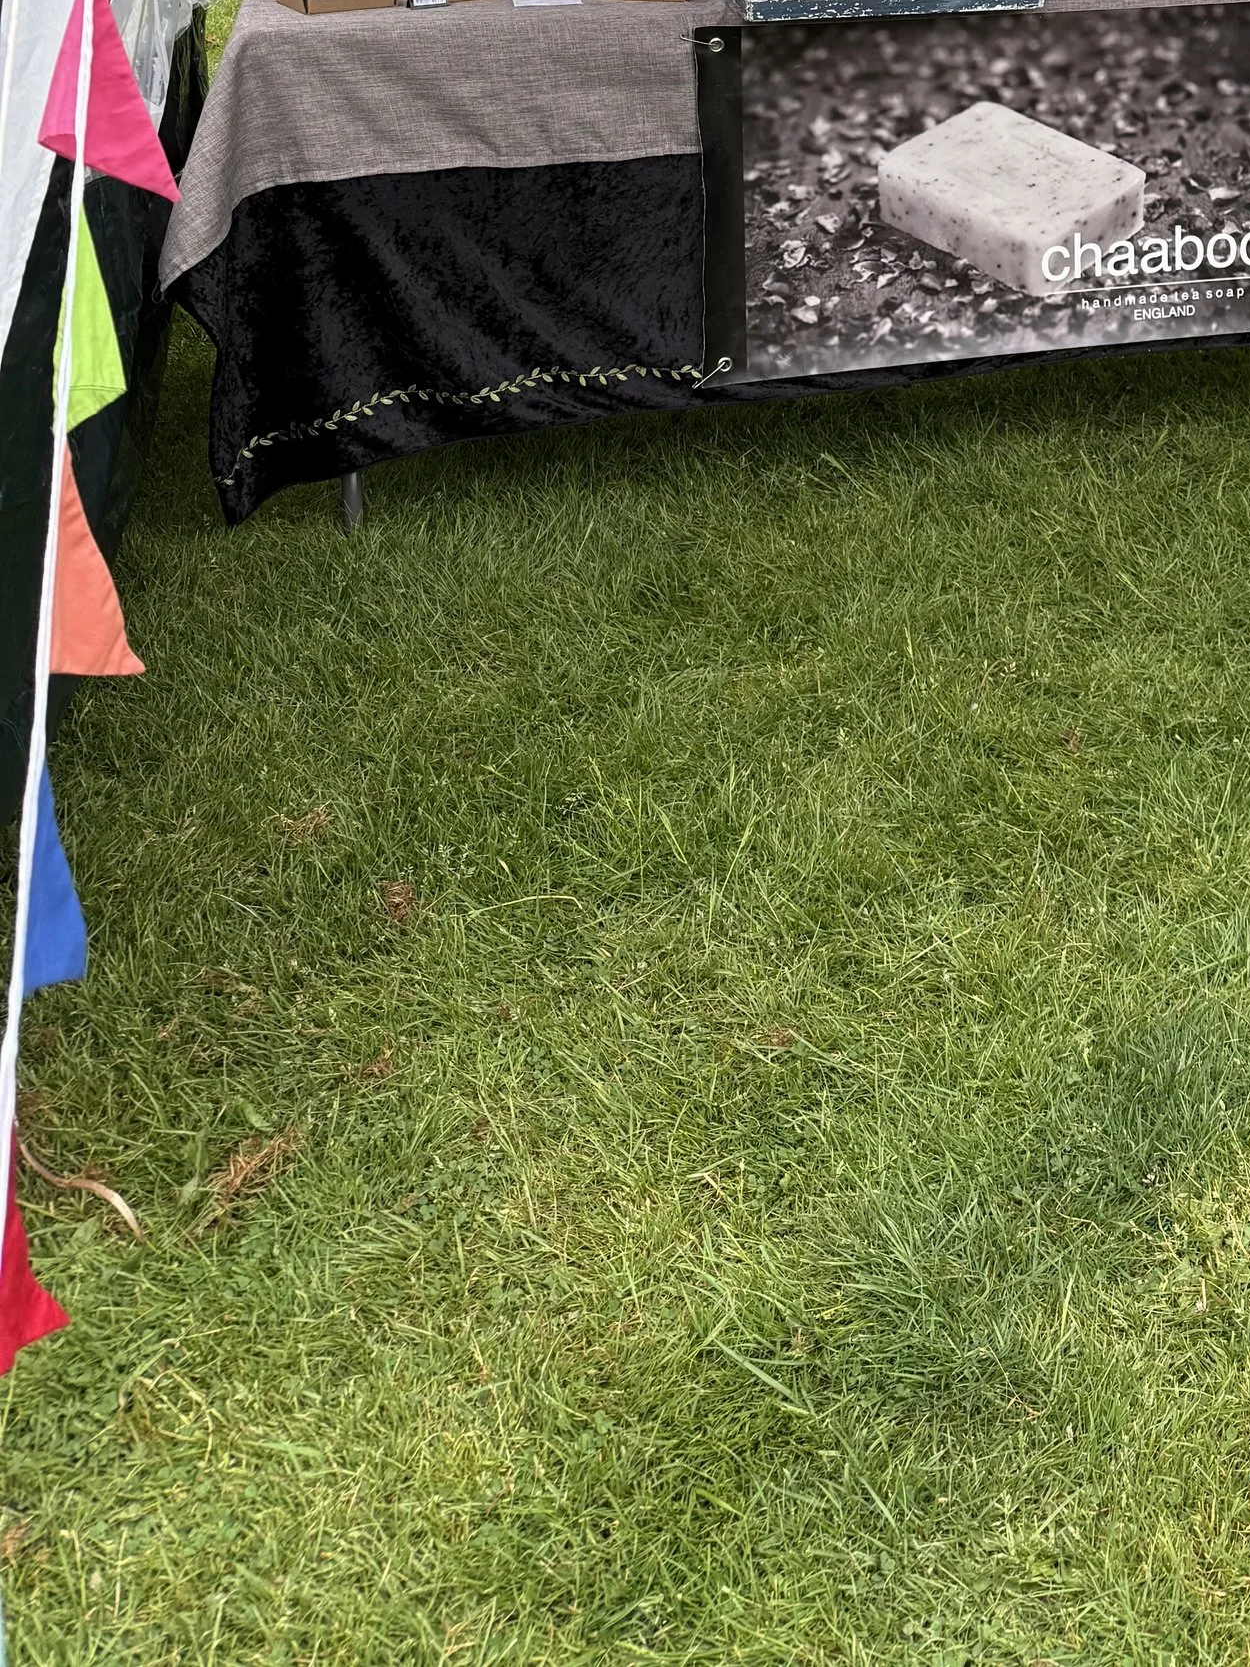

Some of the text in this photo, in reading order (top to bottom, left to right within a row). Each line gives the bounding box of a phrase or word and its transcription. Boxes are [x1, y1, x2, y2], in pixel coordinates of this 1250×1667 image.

[1081, 287, 1245, 309] handmade tea soap
[1133, 304, 1196, 321] ENGLAND
